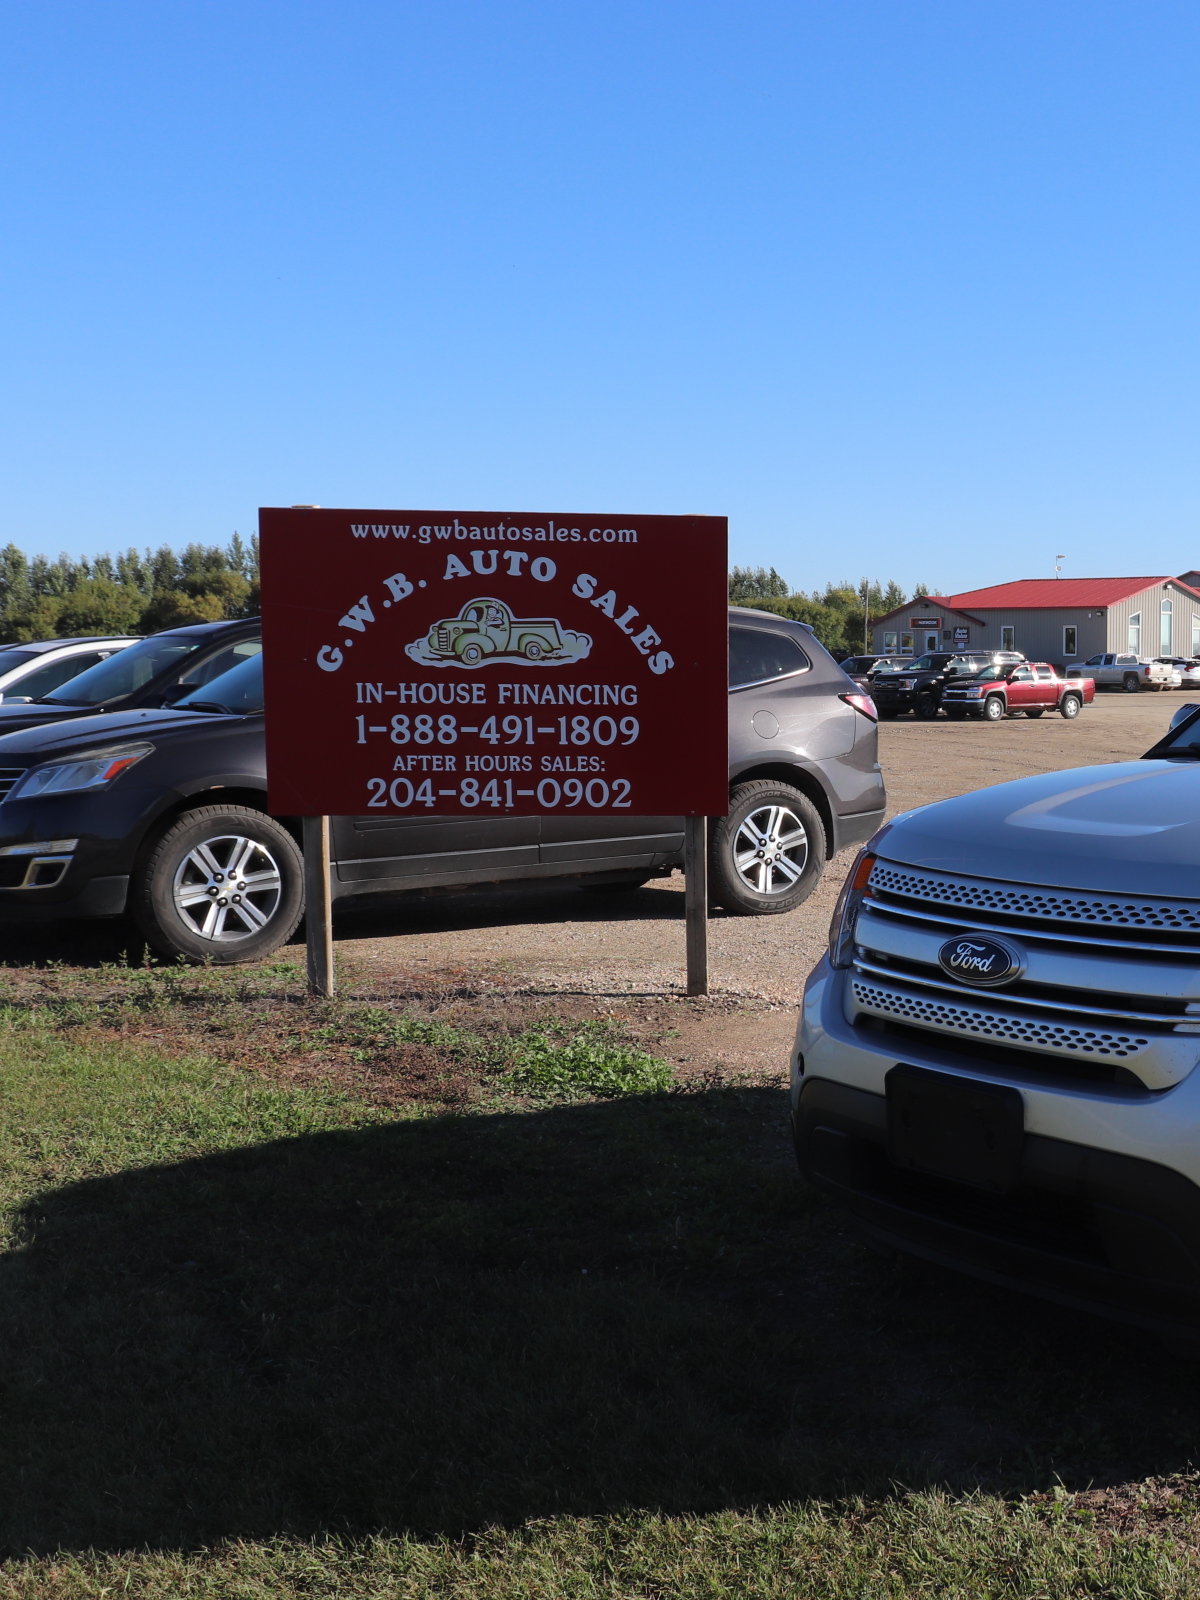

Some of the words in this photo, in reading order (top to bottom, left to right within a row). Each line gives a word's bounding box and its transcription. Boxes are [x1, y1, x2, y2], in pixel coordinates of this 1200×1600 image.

[350, 519, 638, 544] www.gwbautosales.com
[317, 573, 427, 672] G.W.B.
[443, 550, 557, 582] AUTO
[571, 573, 675, 675] SALES
[356, 682, 487, 704] IN-HOUSE
[498, 683, 638, 705] FINANCING
[355, 714, 640, 746] 1-888-491-1809
[393, 755, 457, 771] AFTER
[466, 756, 532, 772] HOURS
[540, 756, 606, 772] SALES:
[367, 778, 632, 807] 204-841-0902
[950, 942, 996, 972] Ford
